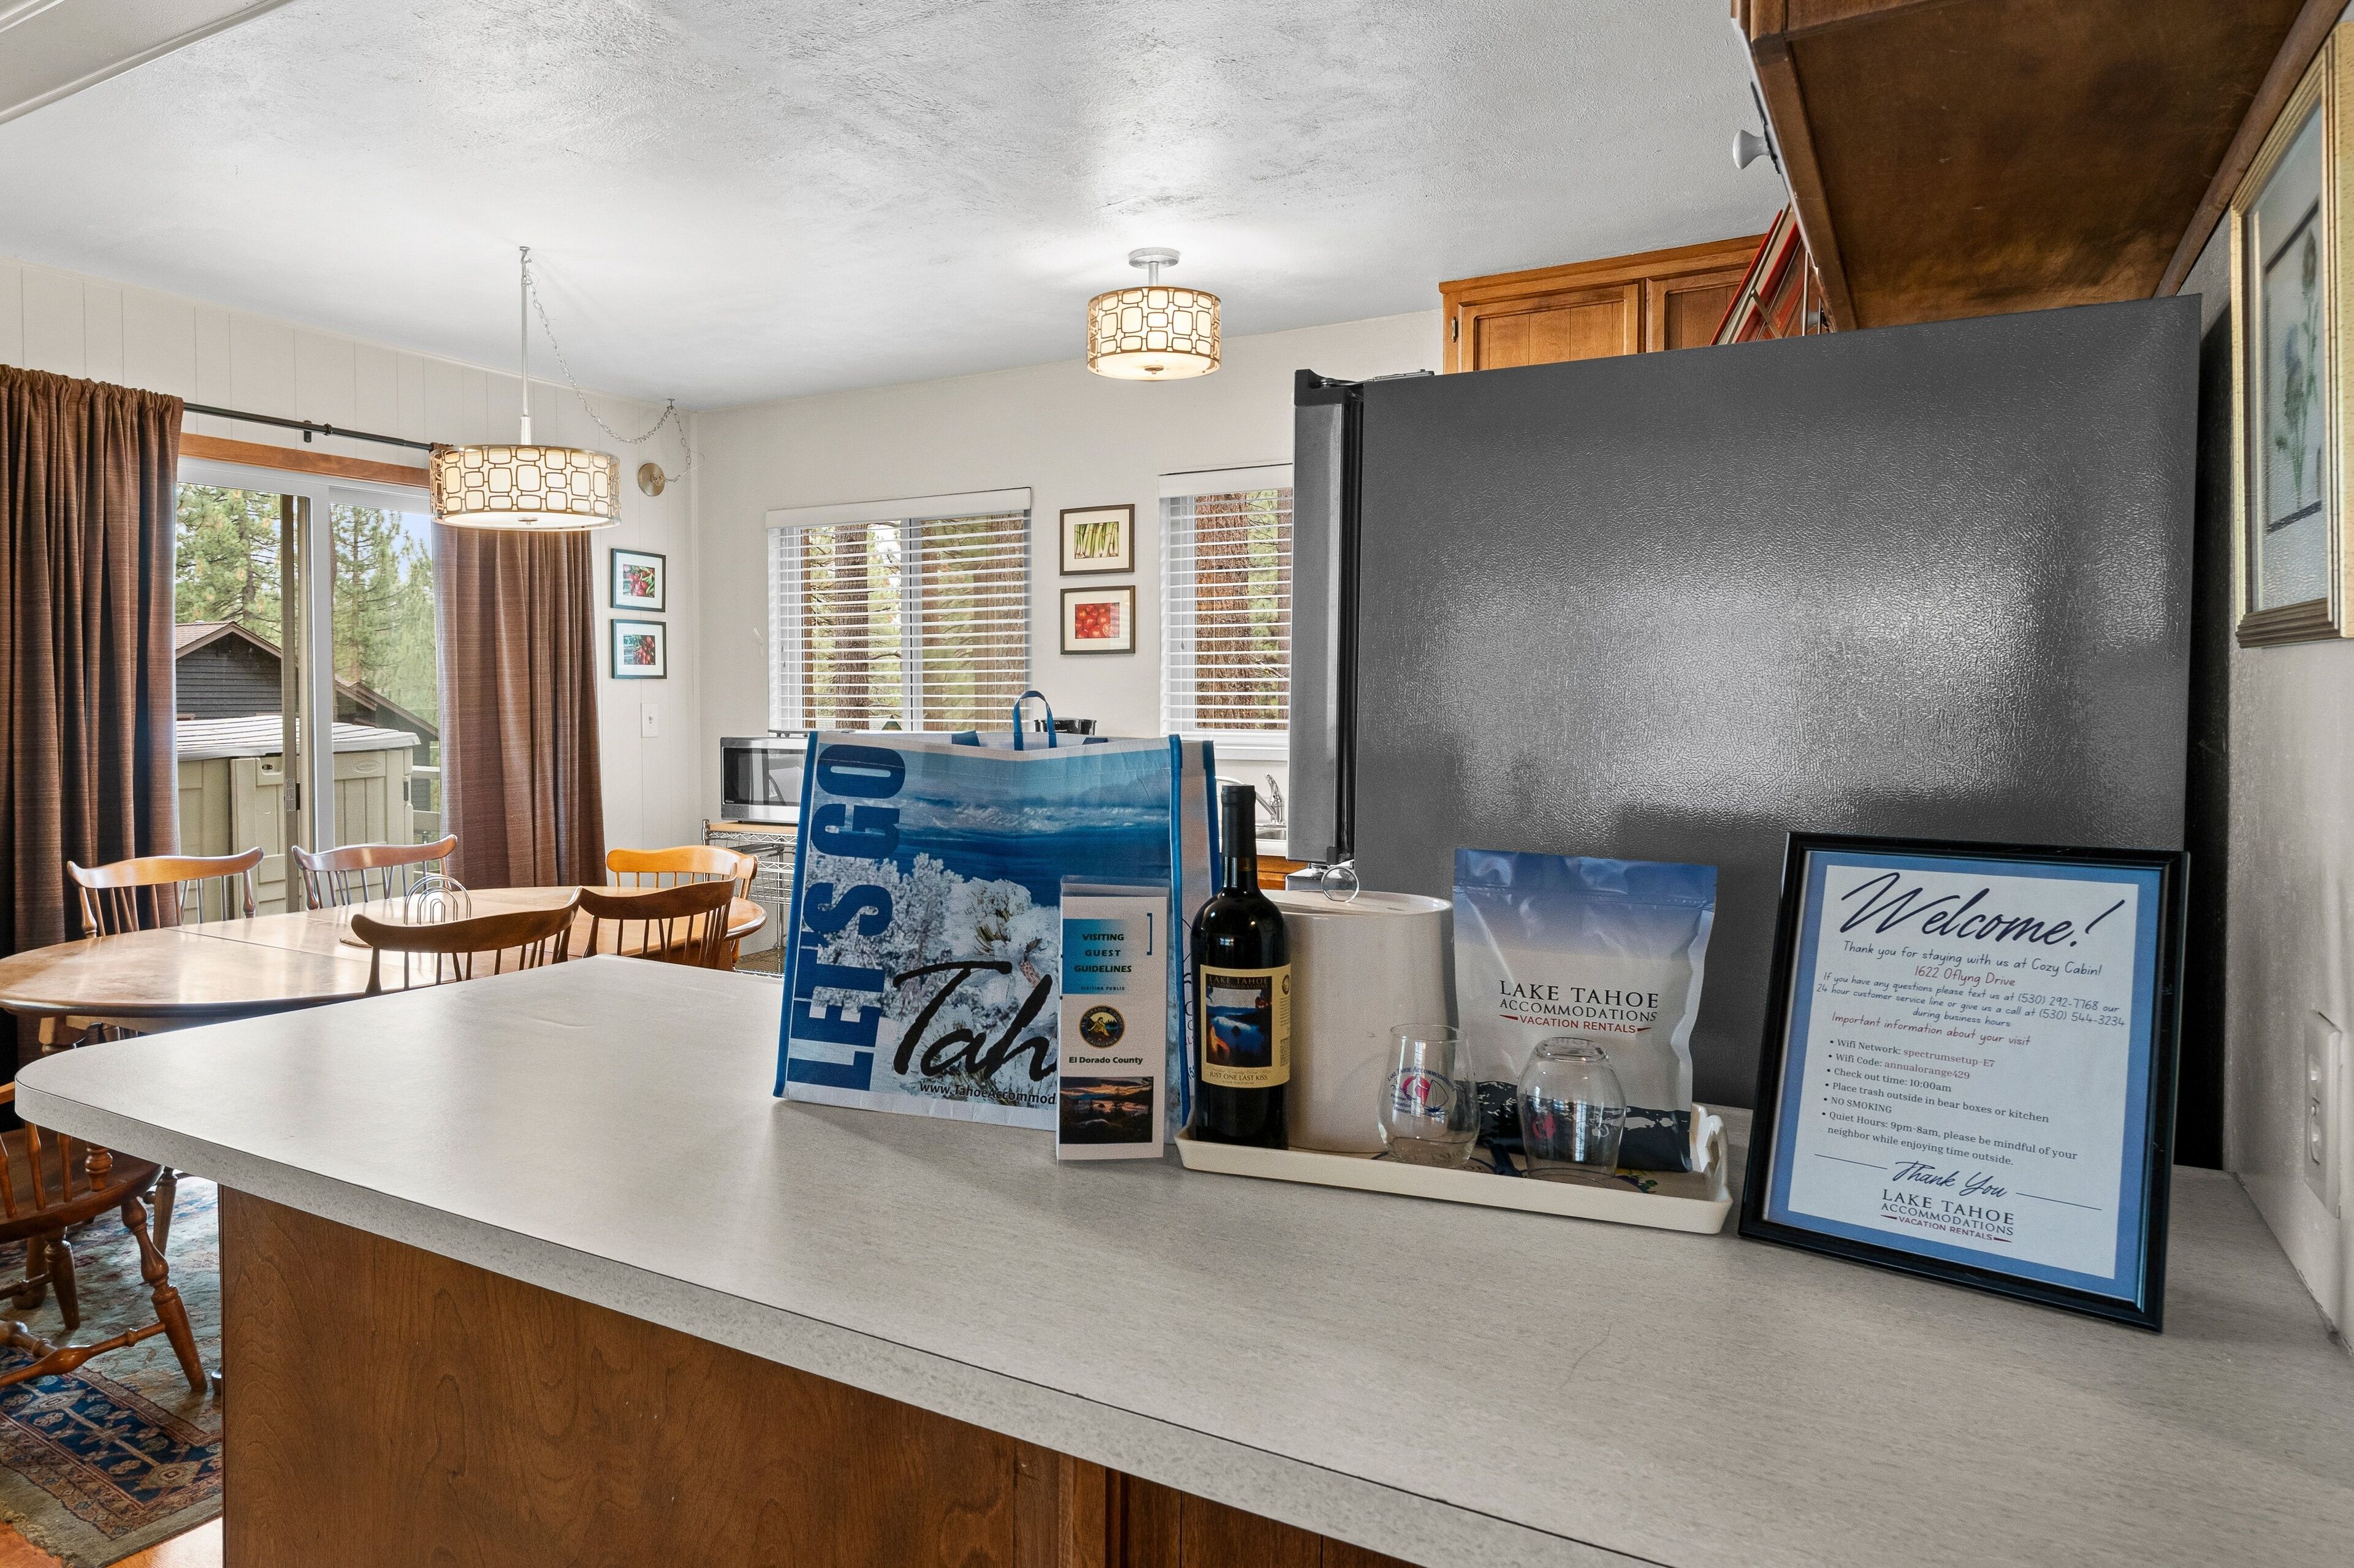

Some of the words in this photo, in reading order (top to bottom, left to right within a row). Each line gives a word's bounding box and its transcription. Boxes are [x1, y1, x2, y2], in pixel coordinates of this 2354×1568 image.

[811, 744, 905, 858] GO
[1840, 872, 2125, 947] Welcome!
[1844, 940, 1873, 954] Thank
[1876, 950, 1896, 959] you
[1902, 946, 1918, 957] for
[1922, 949, 1962, 967] staying
[1967, 953, 1990, 965] with
[2014, 957, 2027, 969] at
[2032, 958, 2059, 976] Cozy
[2065, 961, 2102, 976] Cabin!
[787, 882, 893, 1091] LET'S
[1209, 975, 1231, 984] LAKE
[1914, 965, 1939, 978] 1622
[1985, 972, 2016, 986] Drive
[1499, 980, 1559, 1001] LAKE
[1571, 987, 1658, 1008] TAHOE
[1816, 983, 1827, 992] 24
[1831, 984, 1850, 995] hour
[1853, 989, 1892, 1000] customer
[1895, 995, 1925, 1005] service
[1929, 996, 1944, 1007] line
[1960, 1003, 1978, 1013] give
[2005, 1006, 2021, 1016] call
[2024, 1009, 2036, 1018] at
[2039, 1009, 2066, 1021] (530)
[2071, 1012, 2125, 1027] 544-3234
[1833, 976, 1848, 985] you
[1851, 975, 1870, 986] have
[1873, 981, 1889, 991] any
[1892, 981, 1932, 992] questions
[1935, 985, 1964, 997] please
[1968, 988, 1986, 998] text
[2003, 991, 2014, 1001] at
[2018, 993, 2046, 1005] (530)
[2049, 996, 2099, 1011] 292-7768
[893, 961, 1057, 1082] Tah
[1499, 999, 1657, 1022] ACCOMMODATIONS
[1520, 1015, 1579, 1029] VACATION
[1583, 1021, 1636, 1033] RENTALS
[1913, 1007, 1941, 1022] during
[1944, 1011, 1981, 1024] business
[1985, 1016, 2011, 1027] hours
[1832, 1011, 1881, 1027] Important
[1884, 1019, 1943, 1035] information
[1946, 1027, 1976, 1038] about
[1978, 1034, 2004, 1045] your
[2009, 1035, 2031, 1046] visit
[1836, 1054, 1854, 1063] Wifi
[1857, 1057, 1882, 1067] Code:
[1884, 1061, 1970, 1079] annualorange429
[1837, 1039, 1856, 1049] Wifi
[1858, 1042, 1901, 1054] Network:
[1903, 1049, 1995, 1067] spectrumsetup-E7
[920, 1082, 1057, 1105] www.TahoeAccommod
[1834, 1068, 1862, 1078] Check
[1883, 1076, 1907, 1086] time:
[1910, 1079, 1952, 1092] 10:00am
[1831, 1097, 1845, 1105] NO
[1846, 1099, 1892, 1113] SMOKING
[1832, 1083, 1857, 1093] Place
[1859, 1087, 1884, 1097] trash
[1887, 1092, 1922, 1103] outside
[1925, 1097, 1935, 1105] in
[1938, 1098, 1960, 1109] bear
[1963, 1102, 1992, 1114] boxes
[2008, 1109, 2049, 1123] kitchen
[1827, 1127, 1870, 1140] neighbor
[1872, 1135, 1899, 1145] while
[1901, 1141, 1943, 1155] enjoying
[1946, 1147, 1970, 1157] time
[1972, 1152, 2014, 1165] outside.
[1829, 1112, 1854, 1122] Quiet
[1857, 1116, 1888, 1128] Hours:
[1891, 1122, 1941, 1138] 9pm-8am,
[1943, 1131, 1976, 1143] please
[1979, 1135, 1991, 1145] be
[1994, 1139, 2036, 1153] mindful
[2038, 1147, 2052, 1155] of
[2052, 1149, 2078, 1160] your
[1892, 1161, 1959, 1187] Thank
[1959, 1172, 2007, 1198] You
[1881, 1203, 2014, 1236] ACCOMMODATIONS
[1882, 1189, 1932, 1209] LAKE
[1941, 1200, 2014, 1225] TAHOE
[1899, 1216, 1946, 1231] VACATION
[1950, 1227, 1992, 1241] RENTALS
